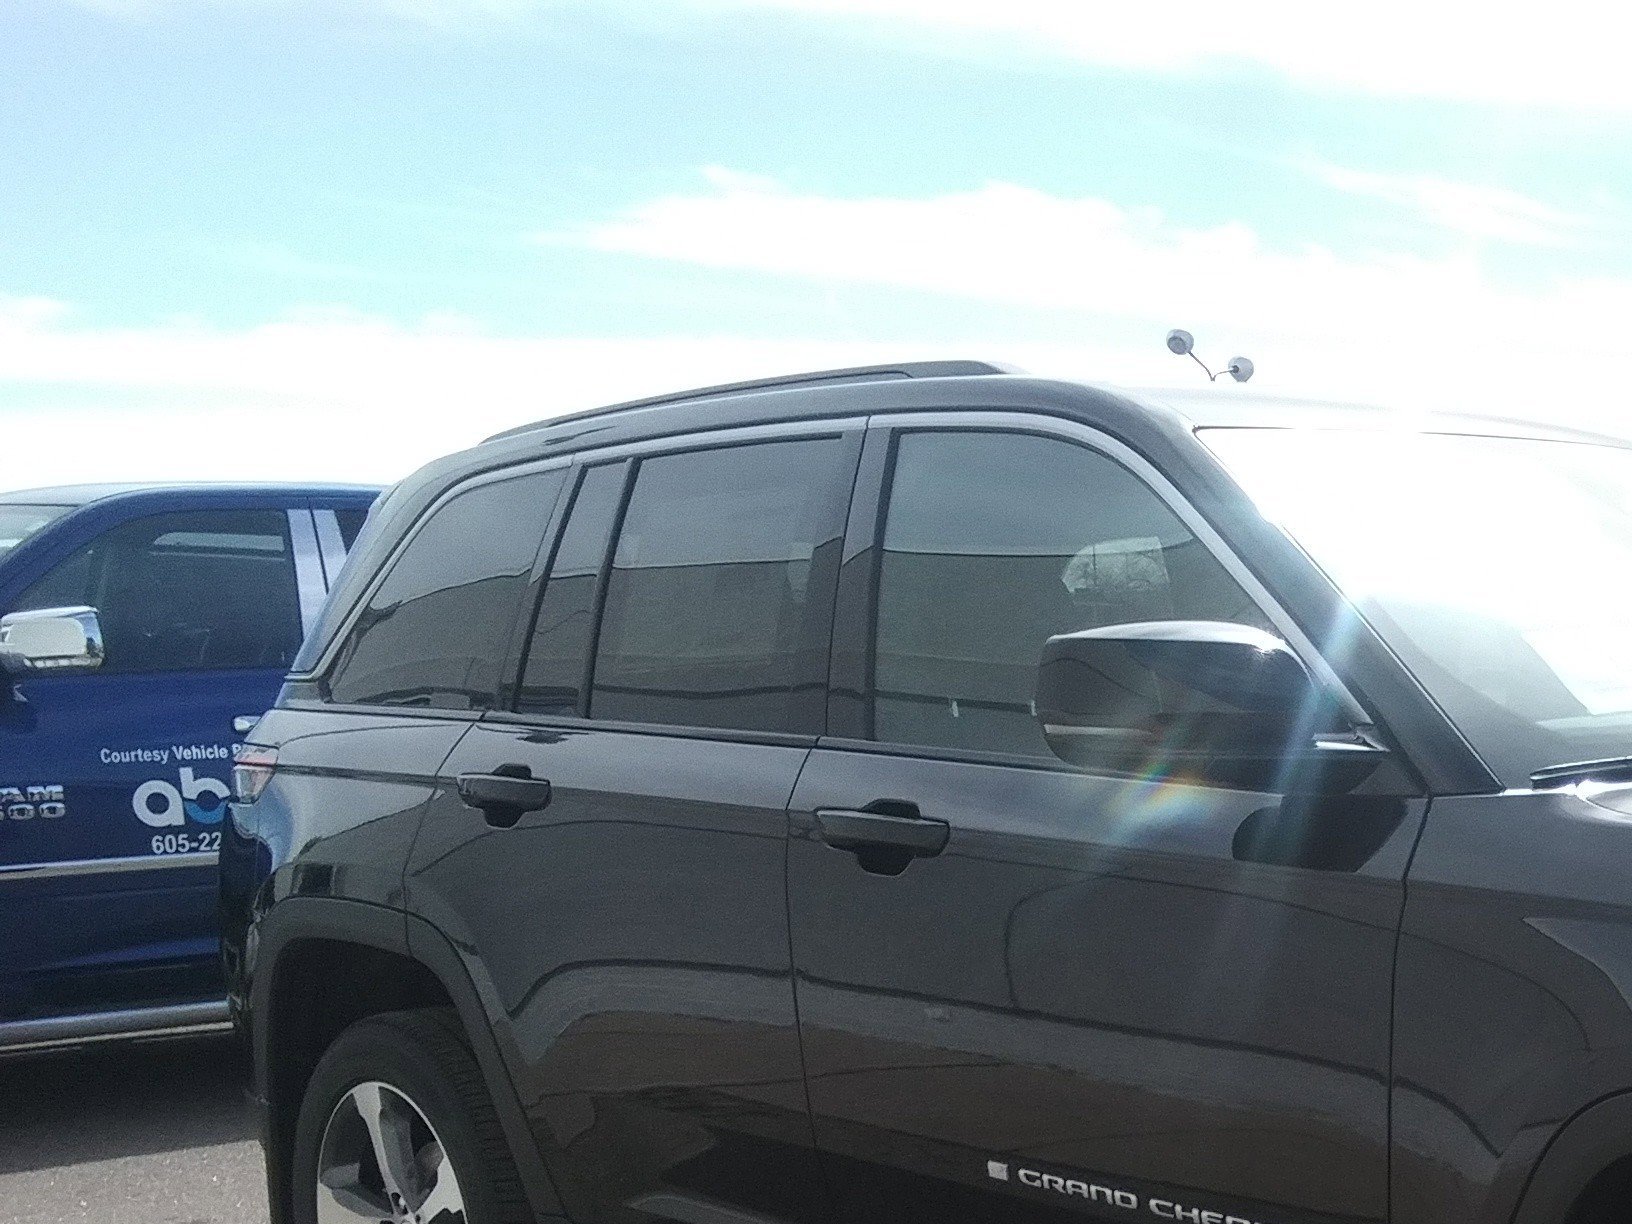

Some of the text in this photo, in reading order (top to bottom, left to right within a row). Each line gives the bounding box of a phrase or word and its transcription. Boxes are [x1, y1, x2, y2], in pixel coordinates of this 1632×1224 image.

[101, 748, 169, 764] Courtesy
[172, 744, 229, 760] Vehicle
[1017, 1168, 1138, 1210] GRAND
